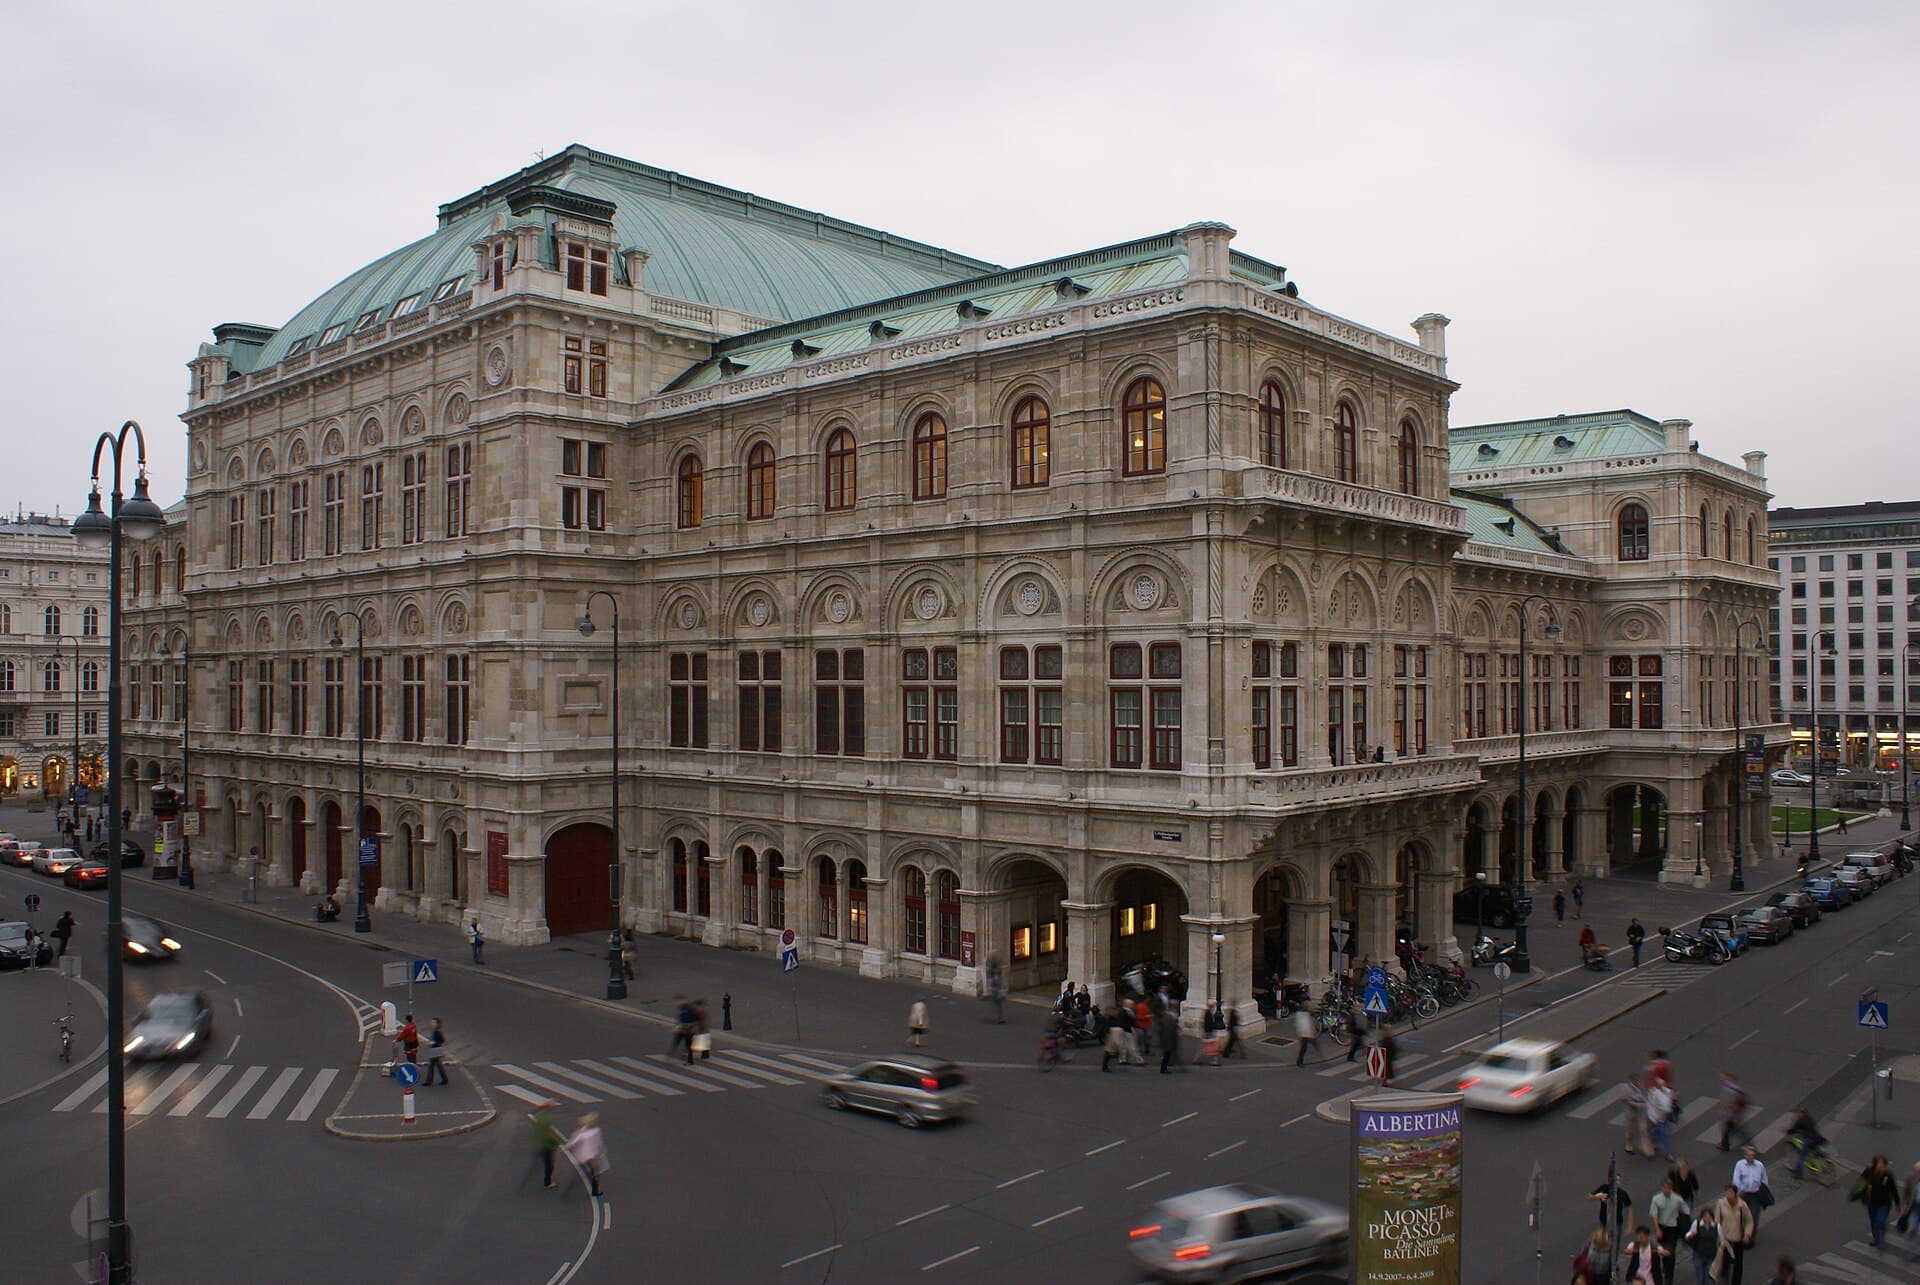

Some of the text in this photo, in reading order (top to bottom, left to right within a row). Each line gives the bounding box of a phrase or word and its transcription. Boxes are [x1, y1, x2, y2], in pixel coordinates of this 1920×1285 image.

[1364, 1109, 1460, 1132] ALBERTINA
[1384, 1204, 1447, 1226] MONET
[1368, 1220, 1441, 1240] PICASSO
[1383, 1245, 1440, 1260] BATLINER
[1396, 1239, 1414, 1250] Die
